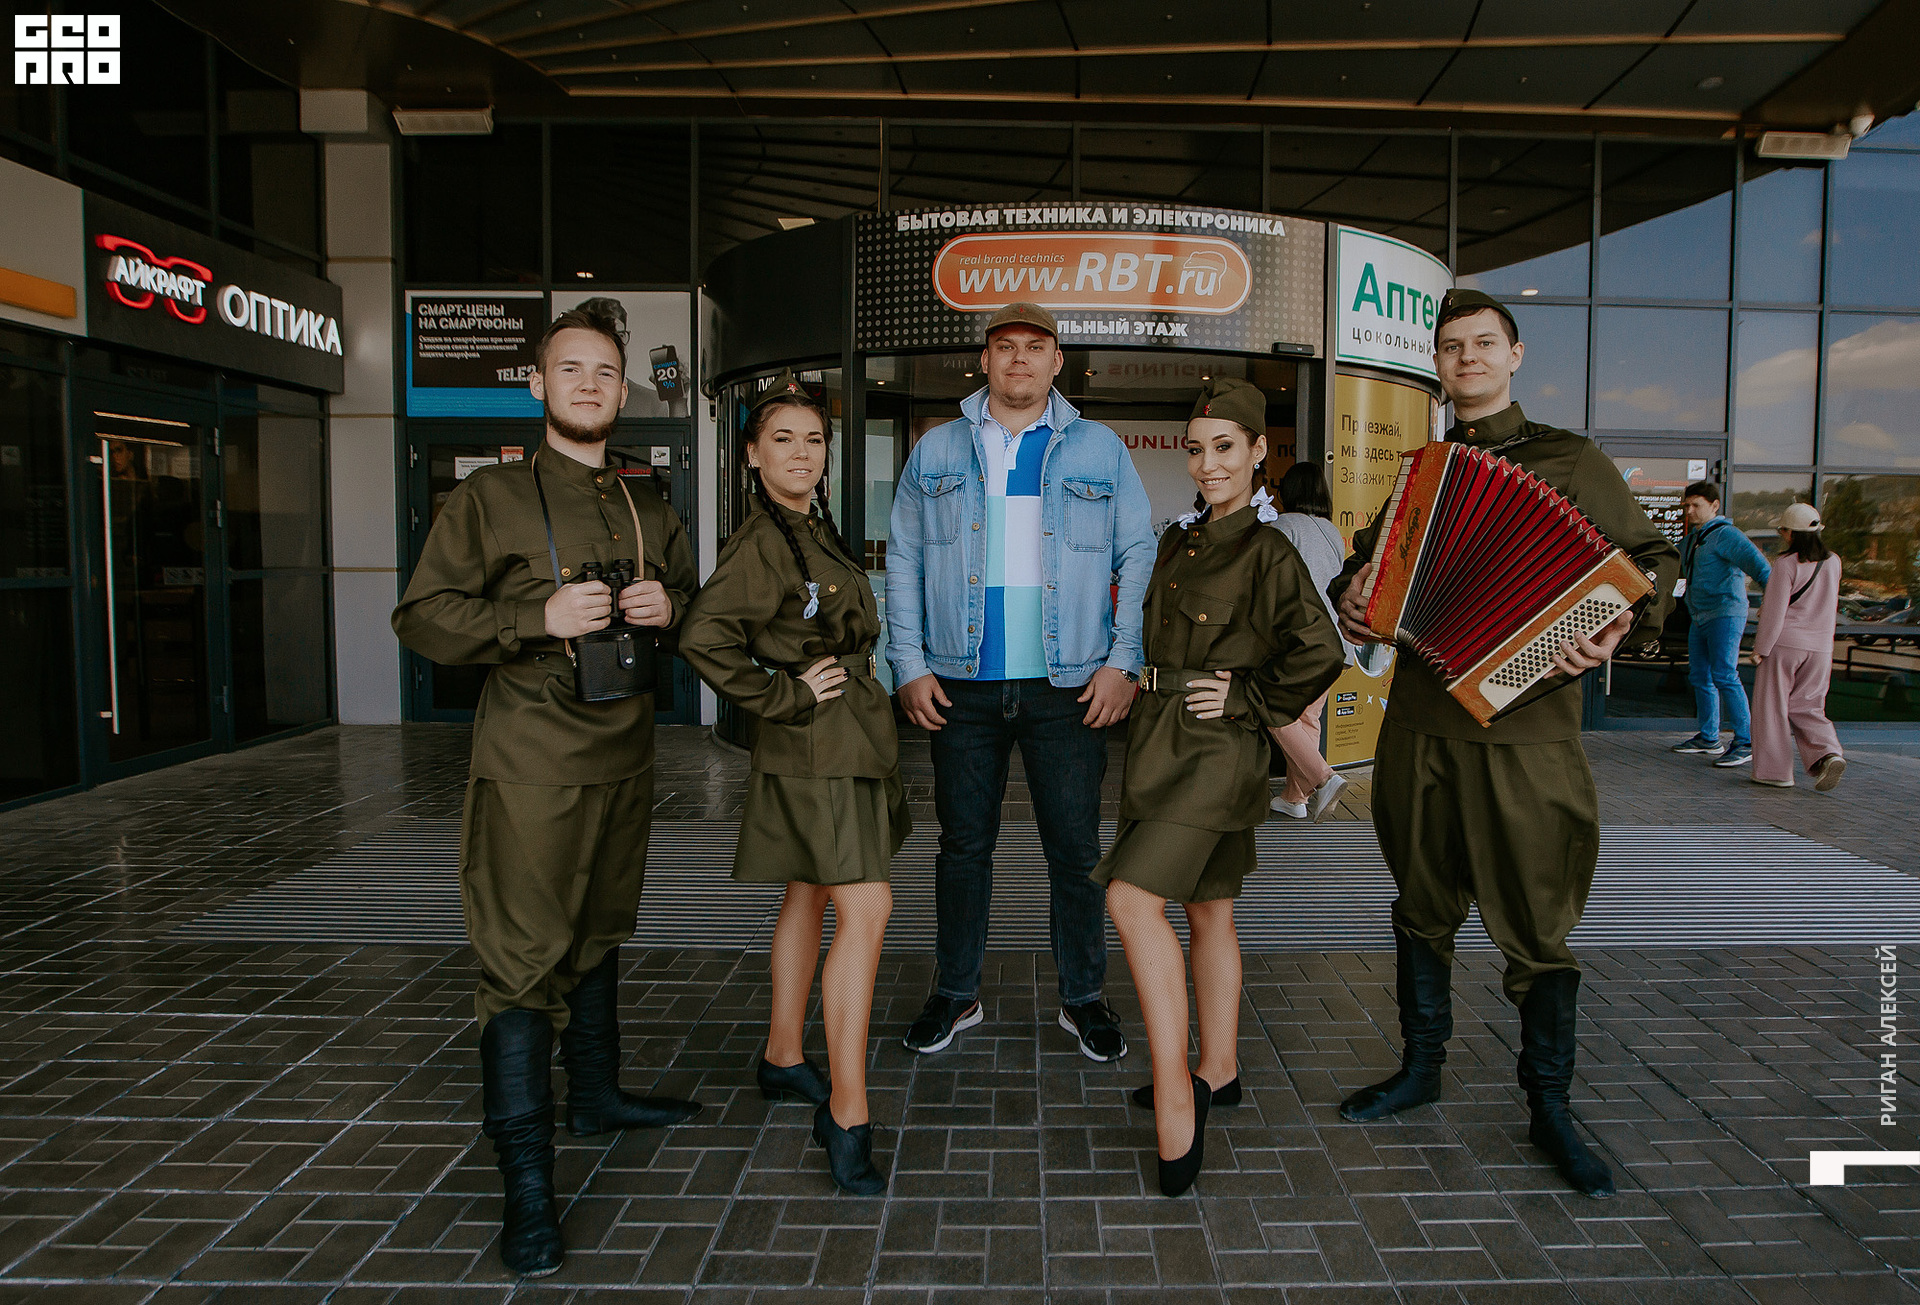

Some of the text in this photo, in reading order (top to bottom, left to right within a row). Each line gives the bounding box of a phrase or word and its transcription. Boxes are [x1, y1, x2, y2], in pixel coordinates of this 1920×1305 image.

[897, 207, 1286, 237] БЫТОВАЯ ТЕХНИКА И ЭЛЕКТРОНИКА
[960, 252, 1065, 265] real brand technics
[109, 254, 206, 307] АЙКРАФТ
[959, 252, 1217, 296] www.RBT.ru
[217, 283, 343, 356] ОПТИКА
[418, 303, 505, 319] СМАРТ-ЦЕНЫ
[418, 317, 524, 330] НА СМАРТФОНЫ
[1133, 321, 1189, 337] ЭТАЖ
[1352, 327, 1432, 356] цокольный
[496, 364, 537, 382] TELE2
[656, 366, 678, 382] 20
[1364, 446, 1394, 464] здесь
[1340, 466, 1385, 487] Закажи
